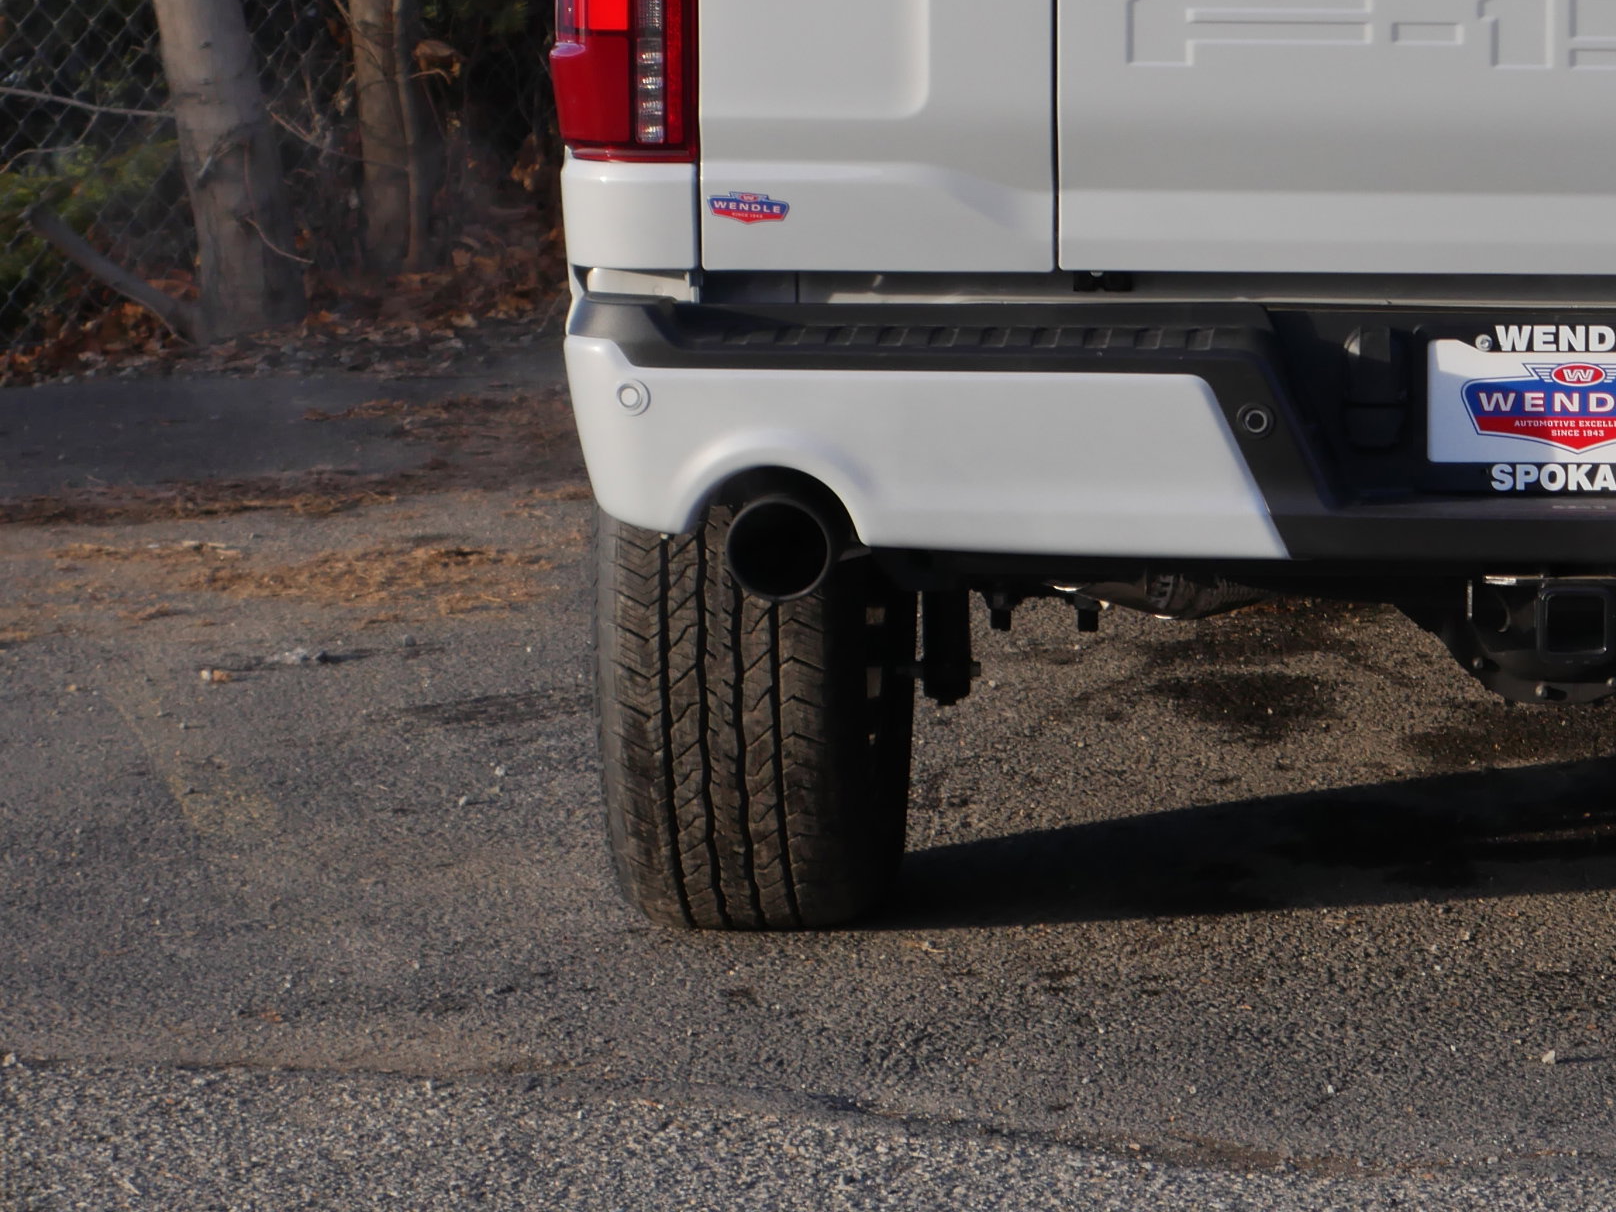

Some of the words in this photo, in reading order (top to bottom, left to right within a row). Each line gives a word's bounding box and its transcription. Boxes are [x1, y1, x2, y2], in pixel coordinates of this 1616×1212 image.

[713, 200, 781, 213] WENDLE
[1562, 368, 1594, 382] W
[1514, 420, 1576, 428] AUTOMOTIVE
[1551, 429, 1580, 437] SINCE
[1583, 429, 1605, 437] 1943
